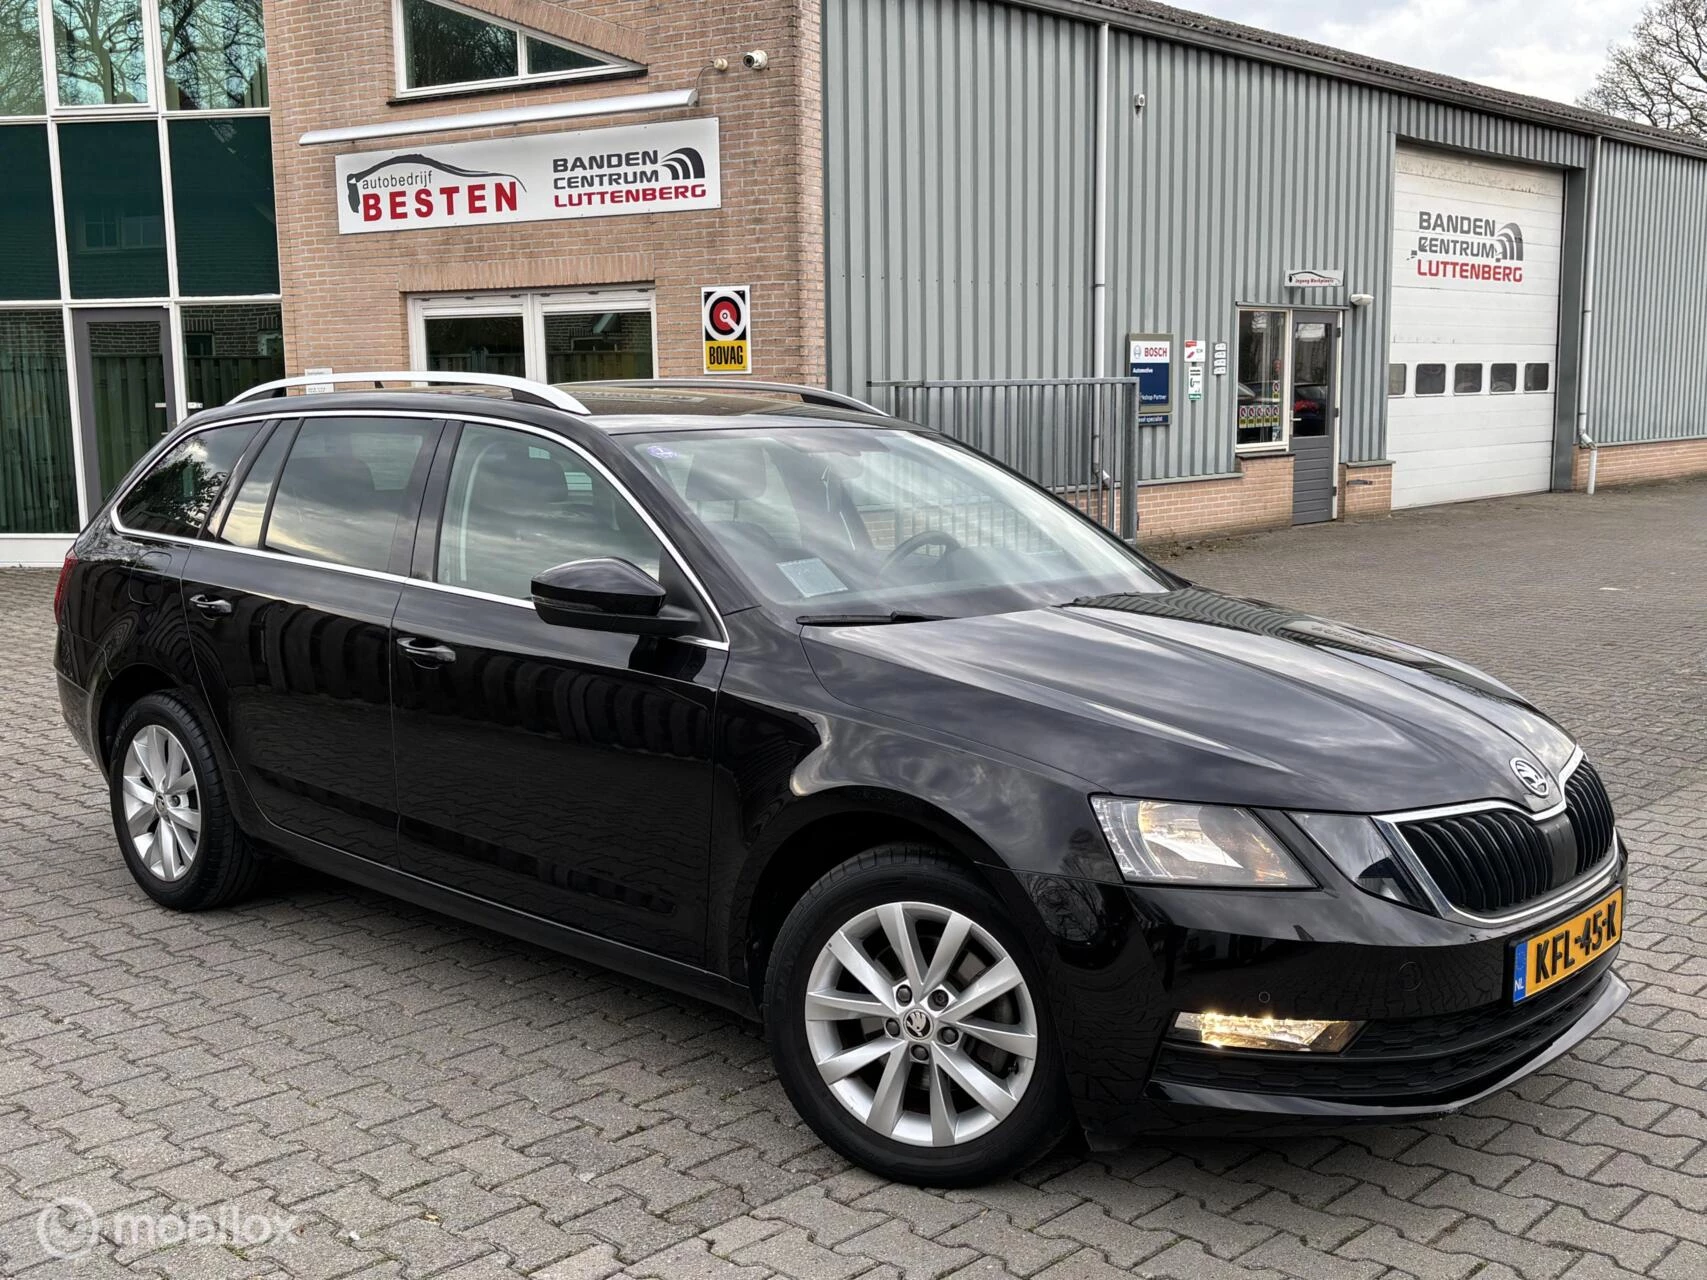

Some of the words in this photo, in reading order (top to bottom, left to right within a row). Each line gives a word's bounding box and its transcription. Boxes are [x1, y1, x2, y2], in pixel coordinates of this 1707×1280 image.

[552, 150, 658, 173] BANDEN
[362, 172, 433, 190] autobedrijf
[553, 170, 659, 190] CENTRUM
[363, 181, 518, 222] BESTEN
[554, 184, 706, 208] LUTTENBERG
[1419, 211, 1496, 237] BANDEN
[1418, 236, 1494, 259] CENTRUM
[1417, 259, 1523, 283] LUTTENBERG
[709, 346, 743, 365] BOVAG
[1144, 347, 1168, 357] BOSCH
[1535, 900, 1617, 984] KFL-45-K
[1514, 977, 1524, 992] NL
